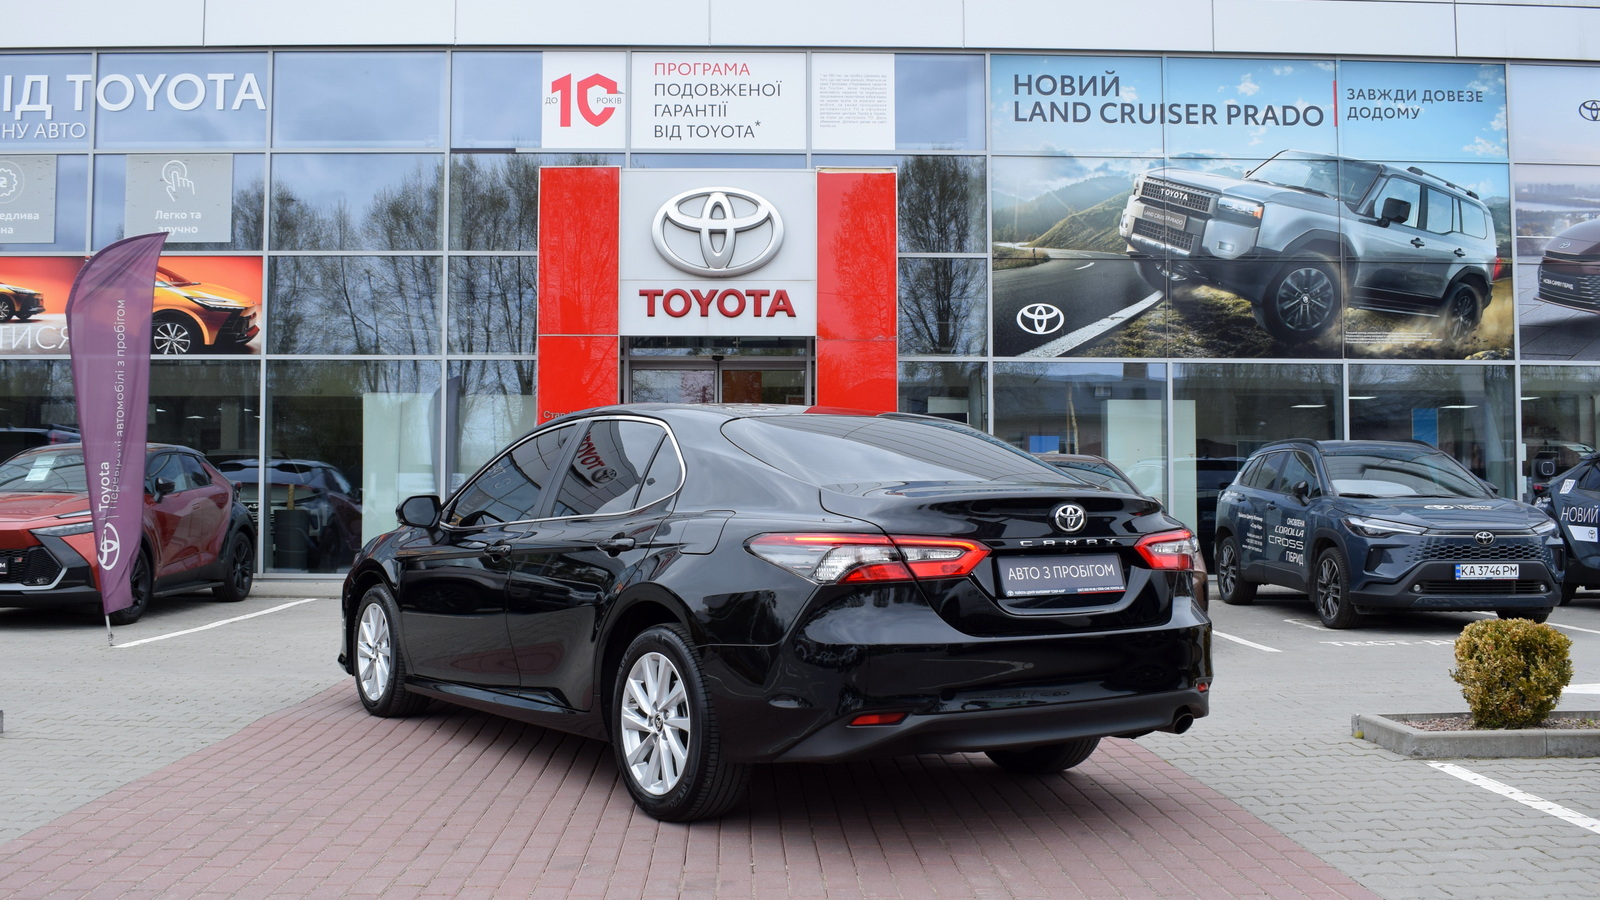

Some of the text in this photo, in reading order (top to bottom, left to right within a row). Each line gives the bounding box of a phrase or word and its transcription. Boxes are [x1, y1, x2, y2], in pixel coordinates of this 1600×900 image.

[654, 62, 750, 76] ПРОГРАМА
[654, 80, 782, 99] ПОДОВЖЕНОЇ
[1014, 70, 1120, 97] НОВИЙ
[66, 72, 266, 112] TOYOTA
[1346, 88, 1484, 104] ЗАВЖДИ ДОВЕЗЕ
[545, 97, 558, 105] ДО
[654, 101, 728, 117] ГАРАНТІЇ
[1014, 101, 1324, 127] LAND CRUISER PRADO
[1346, 106, 1420, 121] ДОДОМУ
[34, 122, 86, 138] АВТО
[654, 125, 682, 140] ВІД
[1160, 188, 1188, 201] TOYOTA
[155, 210, 202, 220] Легко та
[158, 224, 198, 236] зручно
[638, 288, 796, 318] TOYOTA
[114, 300, 127, 356] пробігом
[114, 370, 125, 436] автомобілі
[99, 462, 112, 512] Toyota
[1560, 505, 1598, 524] НОВИЙ
[1274, 525, 1304, 538] COROLLA
[1020, 538, 1117, 547] CAMRY
[1268, 534, 1304, 550] CROSS
[1008, 566, 1040, 581] АВТО
[1053, 564, 1116, 578] ПРОБІГОМ
[1461, 566, 1517, 576] KA 3746 PM
